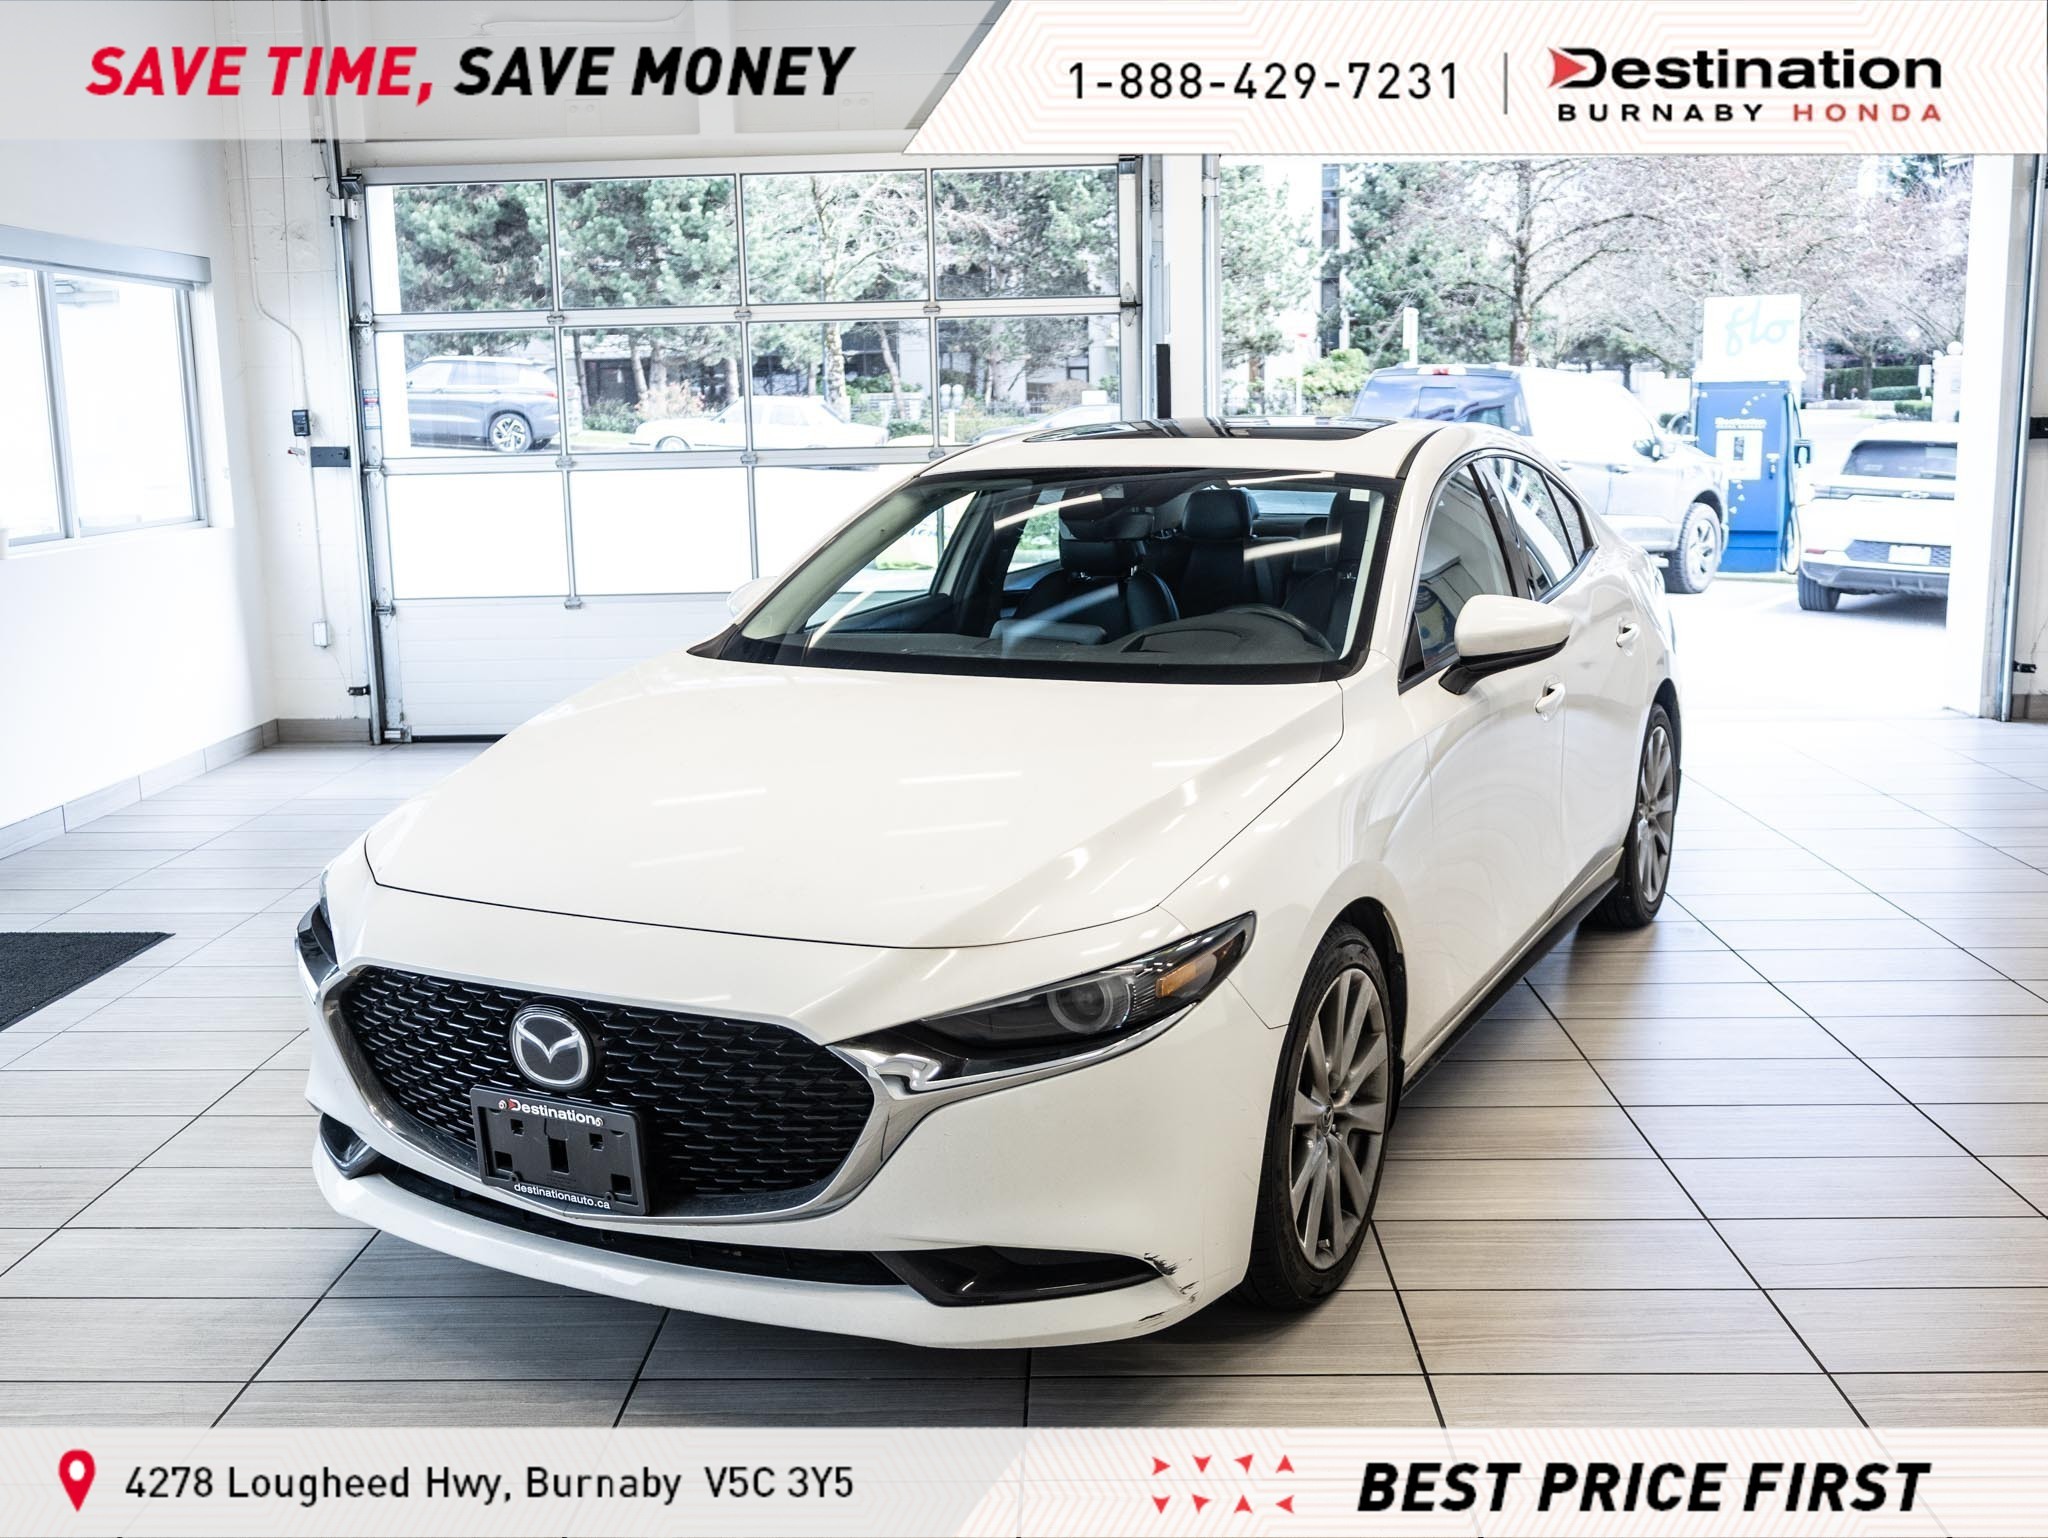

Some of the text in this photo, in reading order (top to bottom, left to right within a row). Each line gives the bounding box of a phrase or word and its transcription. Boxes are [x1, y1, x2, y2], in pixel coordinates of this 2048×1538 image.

[1724, 297, 1795, 356] flo
[508, 1098, 596, 1125] Destination
[513, 1183, 611, 1210] destinationauto.ca
